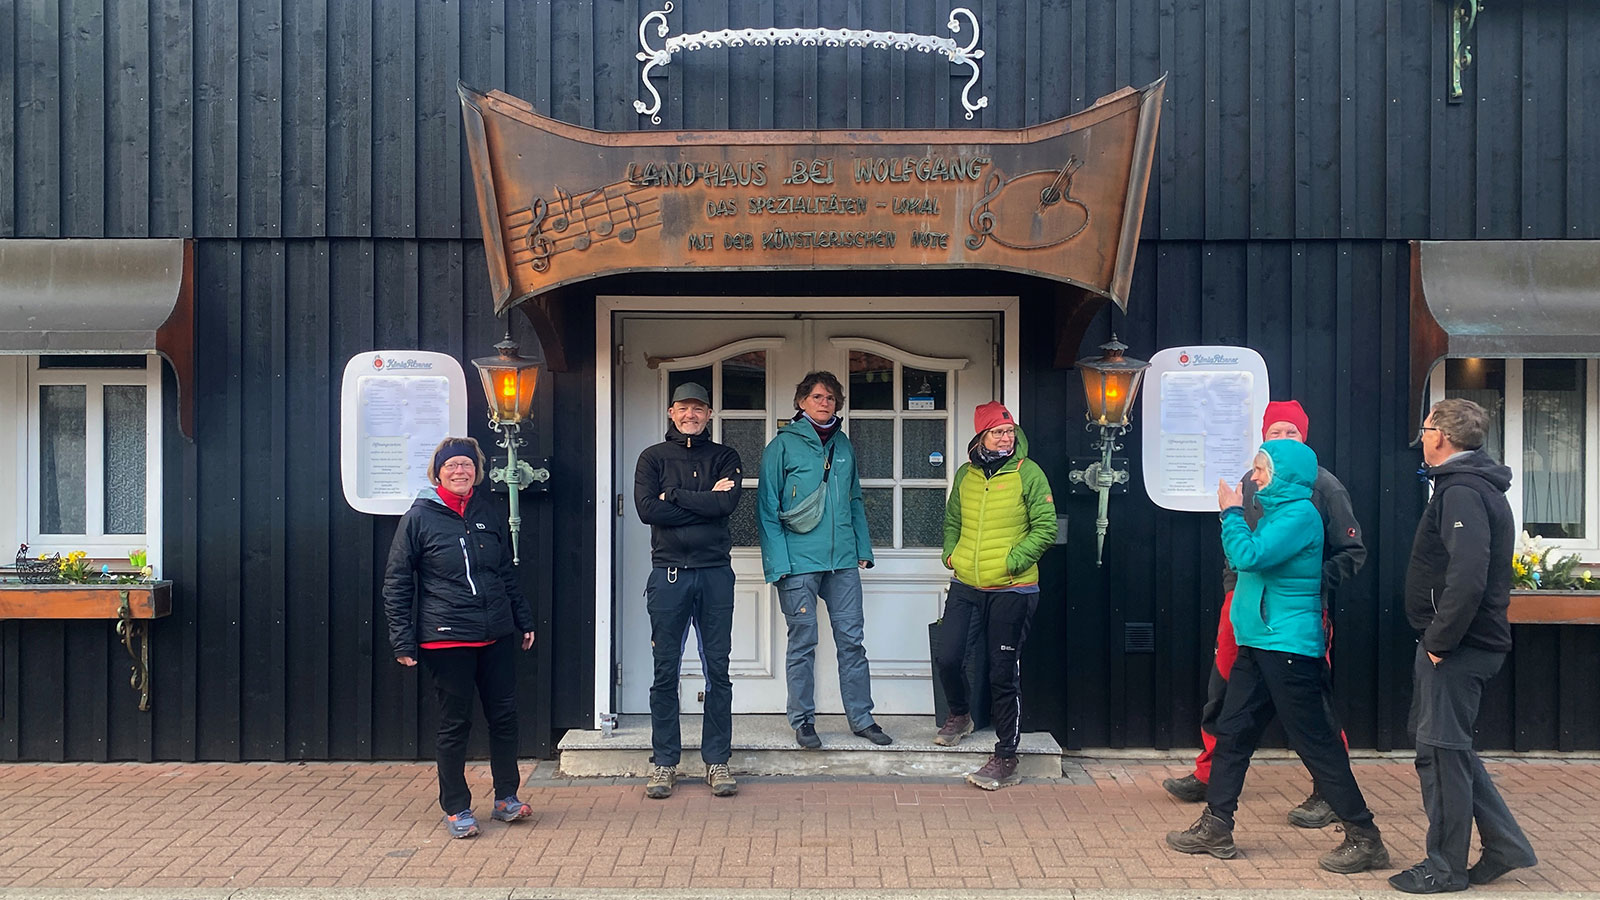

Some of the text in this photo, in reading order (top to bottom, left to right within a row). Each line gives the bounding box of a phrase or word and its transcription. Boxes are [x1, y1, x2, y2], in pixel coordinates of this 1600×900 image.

[706, 198, 738, 218] DAS
[748, 193, 867, 216] SPEZIALITÄTEN
[892, 196, 941, 216] LOKAL
[687, 228, 950, 251] MIT DER KÜNSTLERISCHEN NOTE
